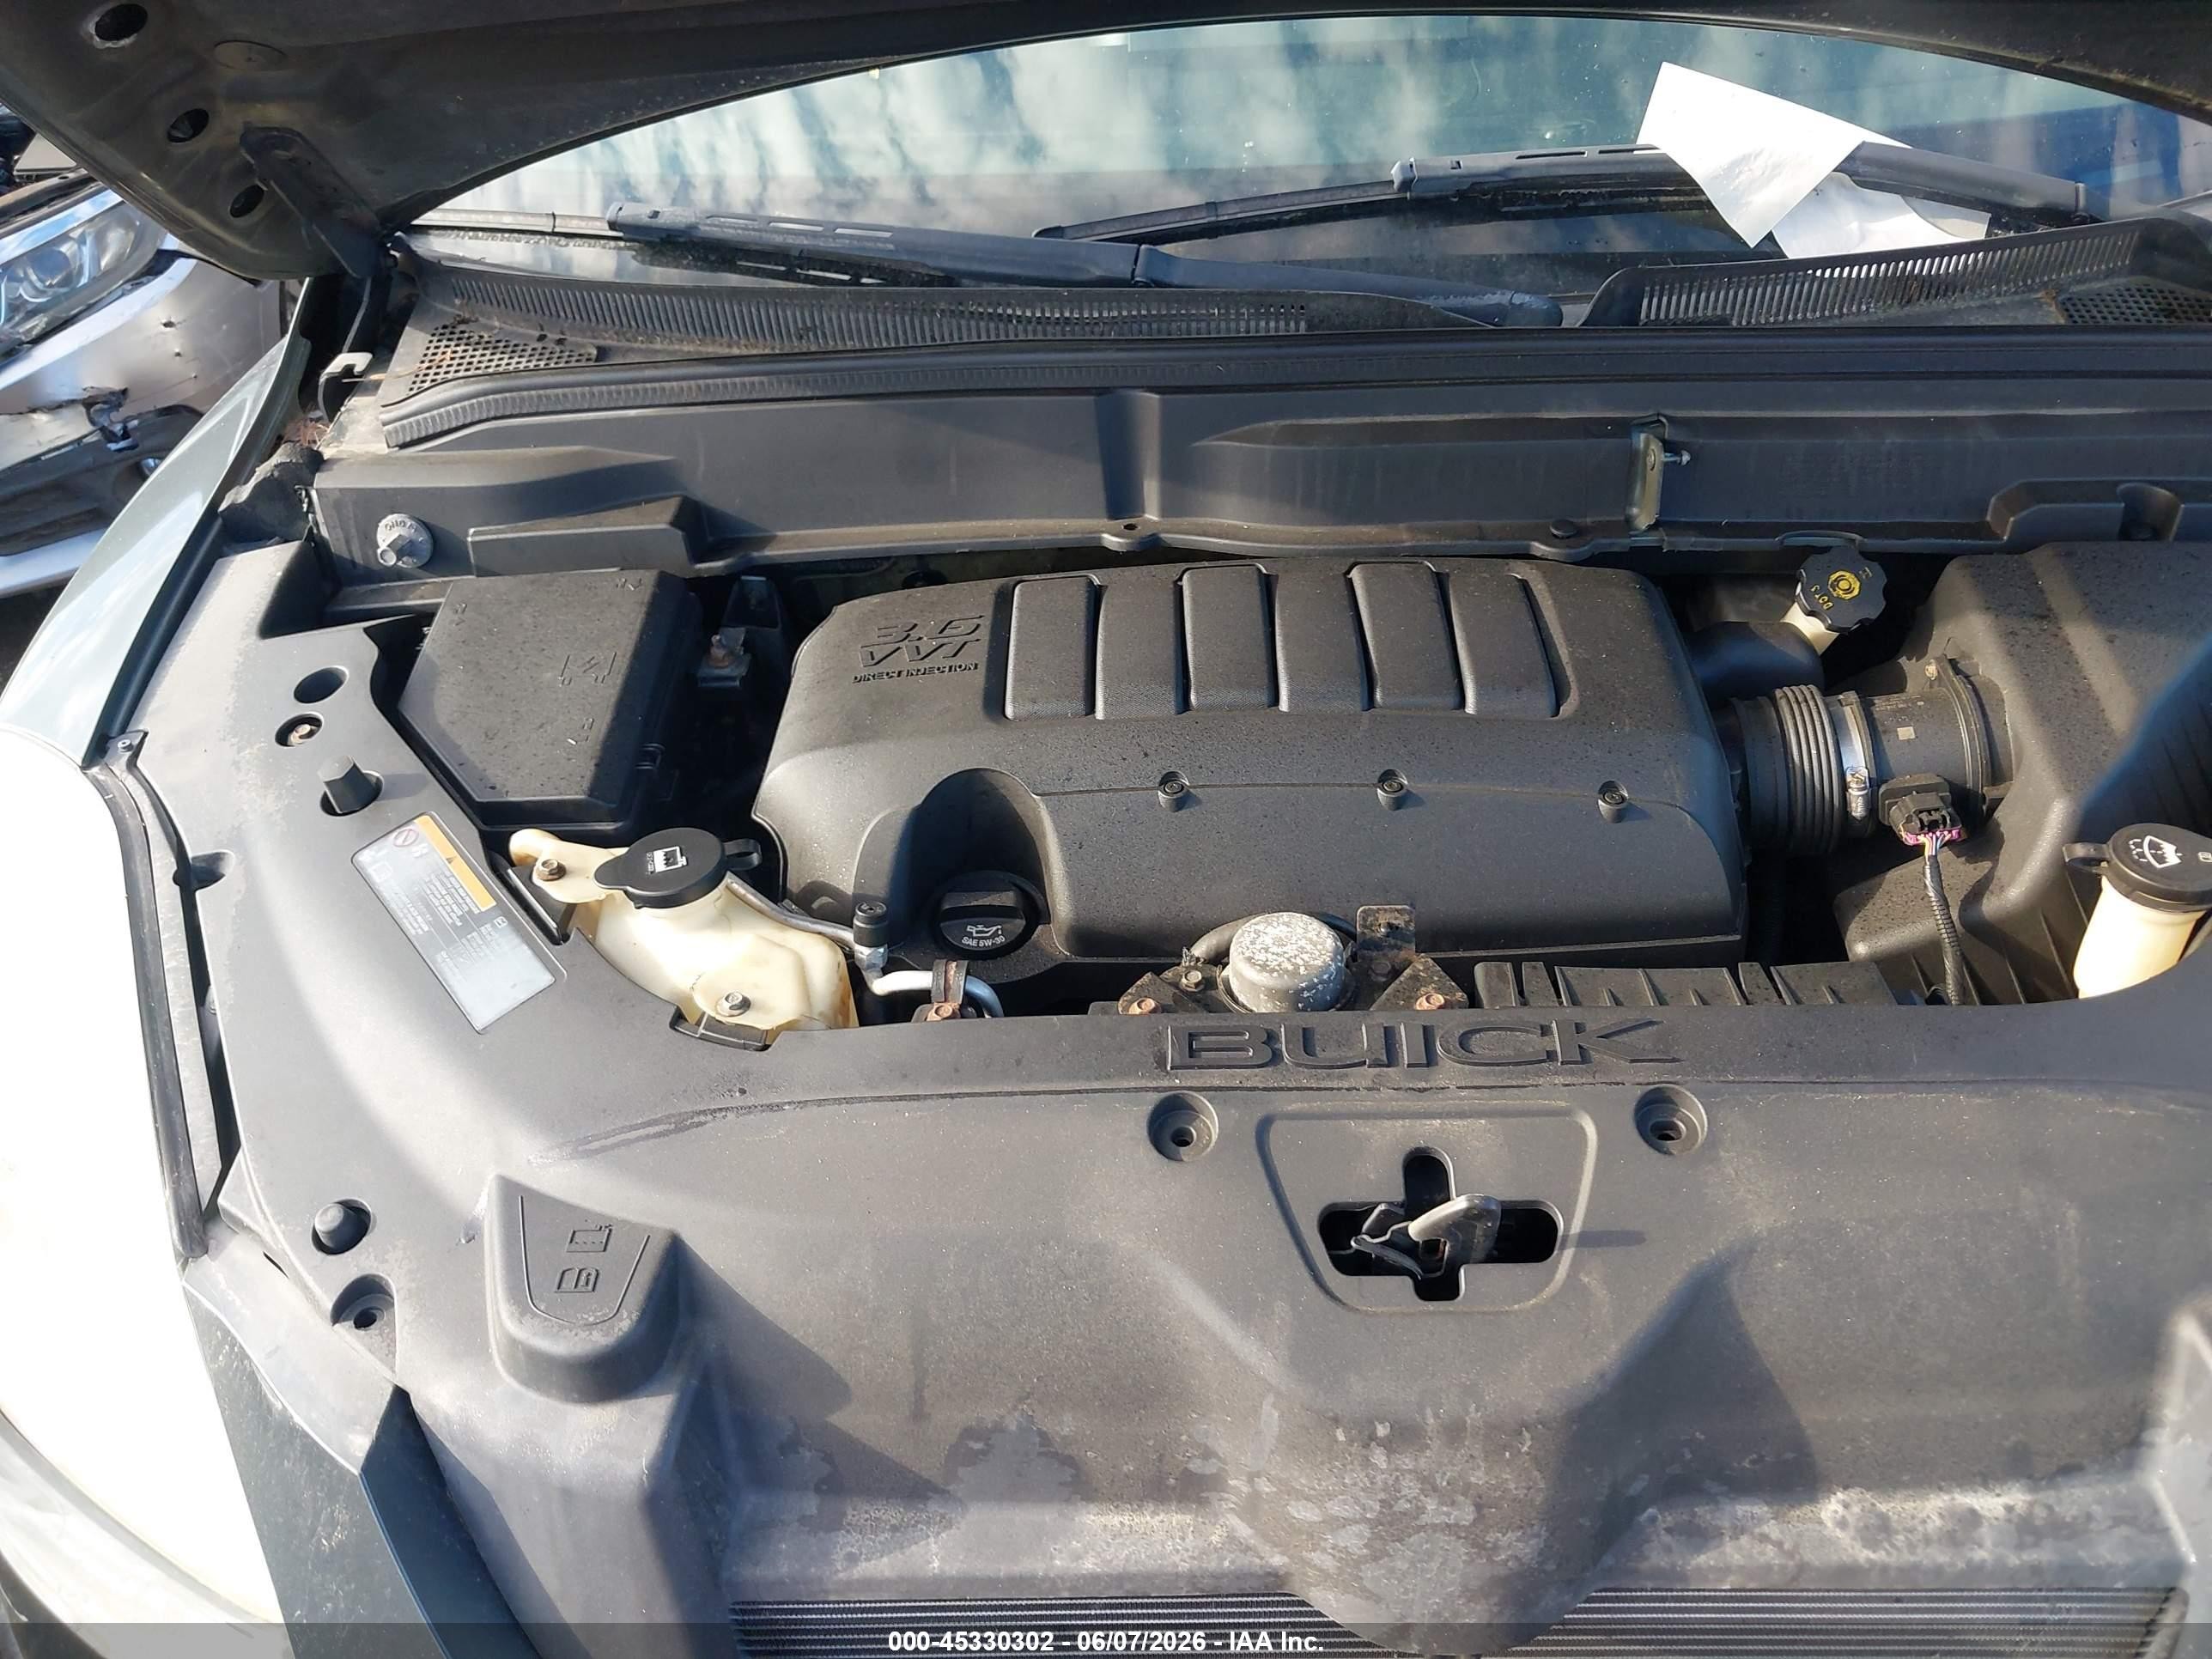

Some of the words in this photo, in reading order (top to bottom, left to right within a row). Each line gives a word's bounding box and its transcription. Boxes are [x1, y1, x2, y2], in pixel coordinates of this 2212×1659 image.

[860, 638, 982, 667] VVT
[852, 670, 903, 684] DIRECT
[906, 661, 979, 678] INJECTION
[961, 936, 978, 946] SAE
[979, 935, 1006, 947] 5W-30
[1165, 1017, 1683, 1070] BUICK
